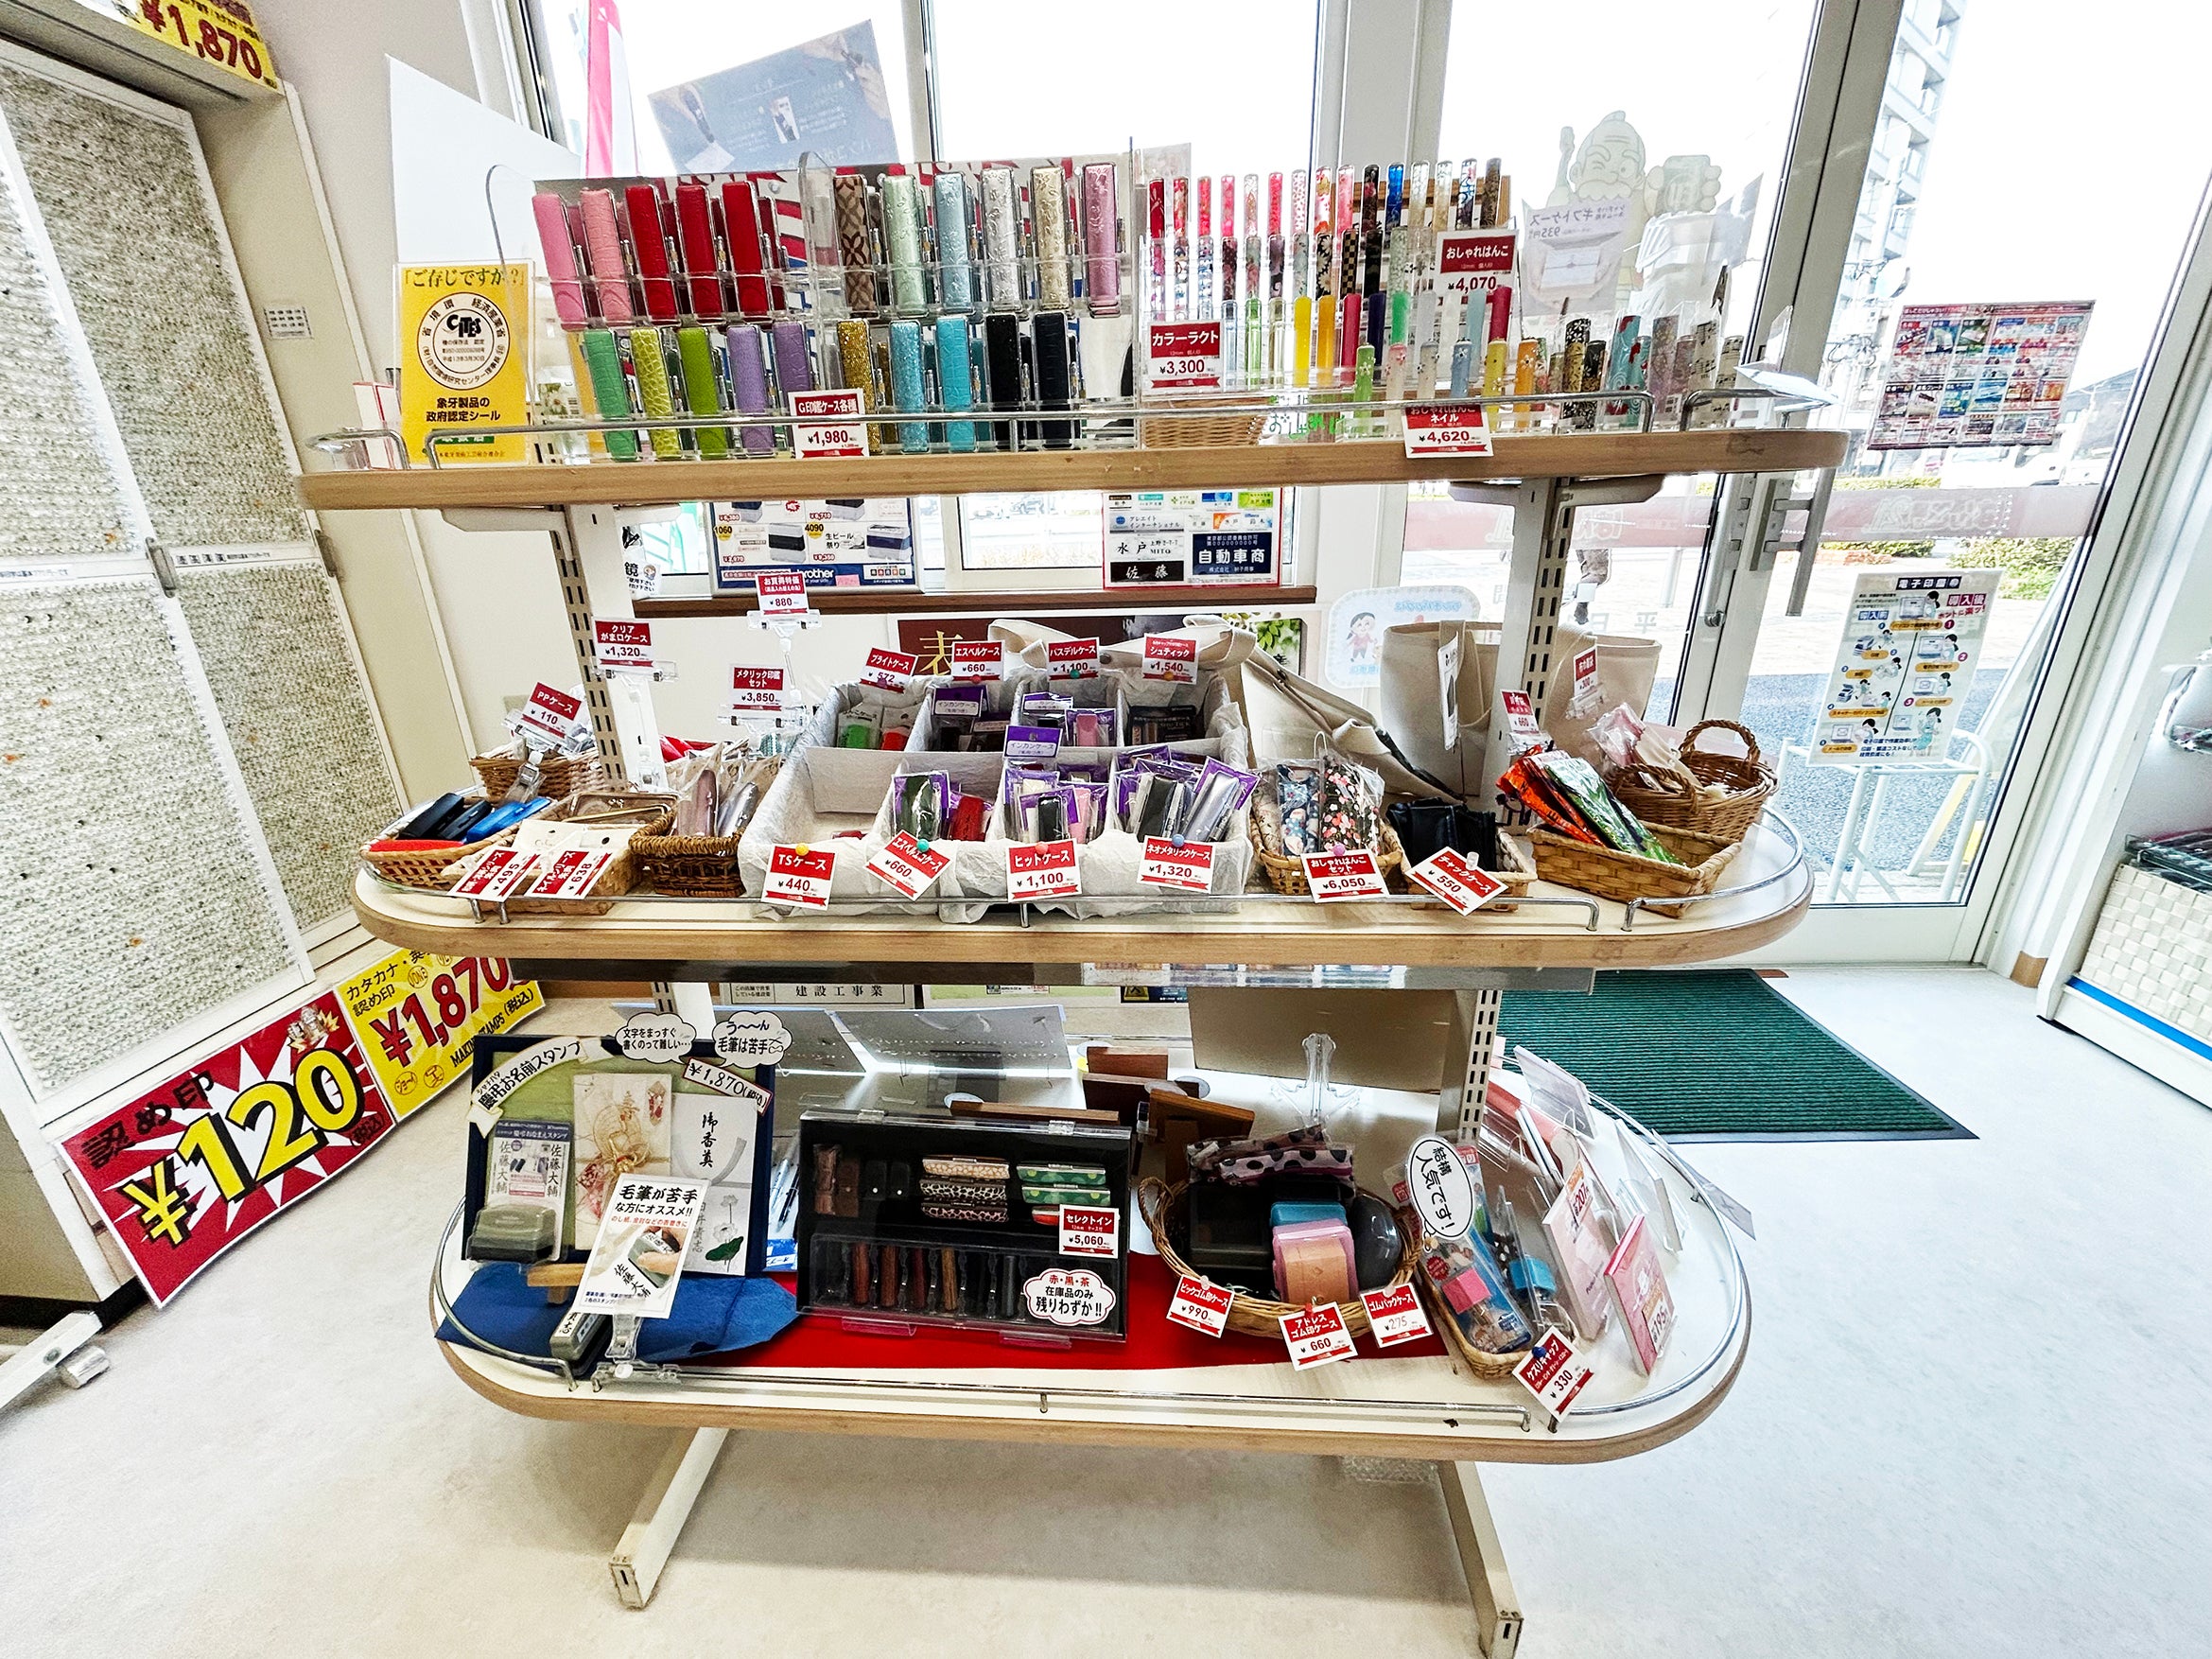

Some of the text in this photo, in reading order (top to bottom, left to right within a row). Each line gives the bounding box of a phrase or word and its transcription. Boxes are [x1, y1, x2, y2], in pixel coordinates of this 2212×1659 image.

[141, 0, 263, 79] ¥1,870
[1446, 245, 1509, 259] おしゃれはんこ
[406, 268, 525, 288] 「ご存じですか？」
[1448, 276, 1497, 294] ¥4,070
[446, 314, 482, 338] CITES
[1152, 330, 1219, 346] カラーラクト
[1159, 358, 1205, 376] ¥3,300
[437, 397, 490, 409] 象牙製品の
[798, 399, 858, 413] G印鑑ケース各種
[426, 410, 500, 422] 政府認定シール
[1430, 413, 1459, 424] ネイル
[808, 430, 848, 446] ¥1,980
[1419, 430, 1470, 445] ¥4,620
[714, 524, 824, 534] 1060 4090
[827, 541, 840, 550] 祭り
[1117, 541, 1147, 555] 水戸
[1198, 549, 1265, 565] 自動車商
[624, 562, 639, 576] 鏡
[769, 598, 792, 606] ¥880
[611, 625, 636, 634] クリア
[601, 633, 648, 643] がま口ケース
[605, 647, 640, 657] ¥1,320
[1150, 646, 1190, 657] シュティック
[870, 654, 910, 672] ブライトケース
[962, 663, 985, 672] ¥660
[1053, 662, 1089, 673] ¥1,100
[1150, 661, 1183, 672] ¥1,540
[736, 670, 781, 680] メタリック印鑑
[748, 678, 768, 689] セット
[537, 690, 574, 714] PPケース
[741, 692, 775, 703] ¥3,850
[531, 708, 559, 725] ¥110
[1014, 849, 1071, 868] ヒットケース
[1146, 844, 1211, 862] ネオメタリックケース
[778, 853, 827, 871] TSケース
[884, 858, 913, 879] ¥660
[1311, 855, 1367, 868] おしゃれはんこ
[1328, 864, 1353, 874] セット
[493, 863, 520, 891] ¥495
[568, 863, 593, 891] ¥638
[1149, 864, 1193, 878] ¥1,320
[1437, 854, 1492, 894] チャックケース
[778, 877, 810, 892] ¥440
[1017, 872, 1064, 887] ¥1,100
[1322, 877, 1366, 891] ¥6,050
[1428, 869, 1462, 893] ¥550
[346, 950, 431, 1002] カタカナ・英
[795, 985, 884, 998] 建設工事業
[352, 984, 396, 1018] 認め印
[503, 987, 534, 1017] (税込)
[622, 1027, 677, 1039] 文字をまっすぐ
[450, 1037, 476, 1068] MAKIN
[717, 1038, 769, 1056] 毛筆は苦手
[81, 1070, 215, 1169] 認め印
[117, 1047, 367, 1248] ¥120
[1432, 1146, 1453, 1177] 結構
[619, 1184, 698, 1205] 毛筆が苦手
[1416, 1155, 1455, 1231] 人気です!
[615, 1202, 693, 1217] な方にオススメ!!
[1066, 1214, 1112, 1227] セレクトイン
[1069, 1235, 1104, 1246] ¥5,060
[1049, 1274, 1090, 1287] 赤・黒・茶
[1045, 1285, 1094, 1300] 在庫品のみ
[1181, 1304, 1210, 1320] ¥990
[1295, 1313, 1327, 1329] アドレス
[1290, 1320, 1338, 1339] ゴム印ケース
[1300, 1337, 1332, 1353] ¥660
[1549, 1370, 1574, 1399] ¥330
